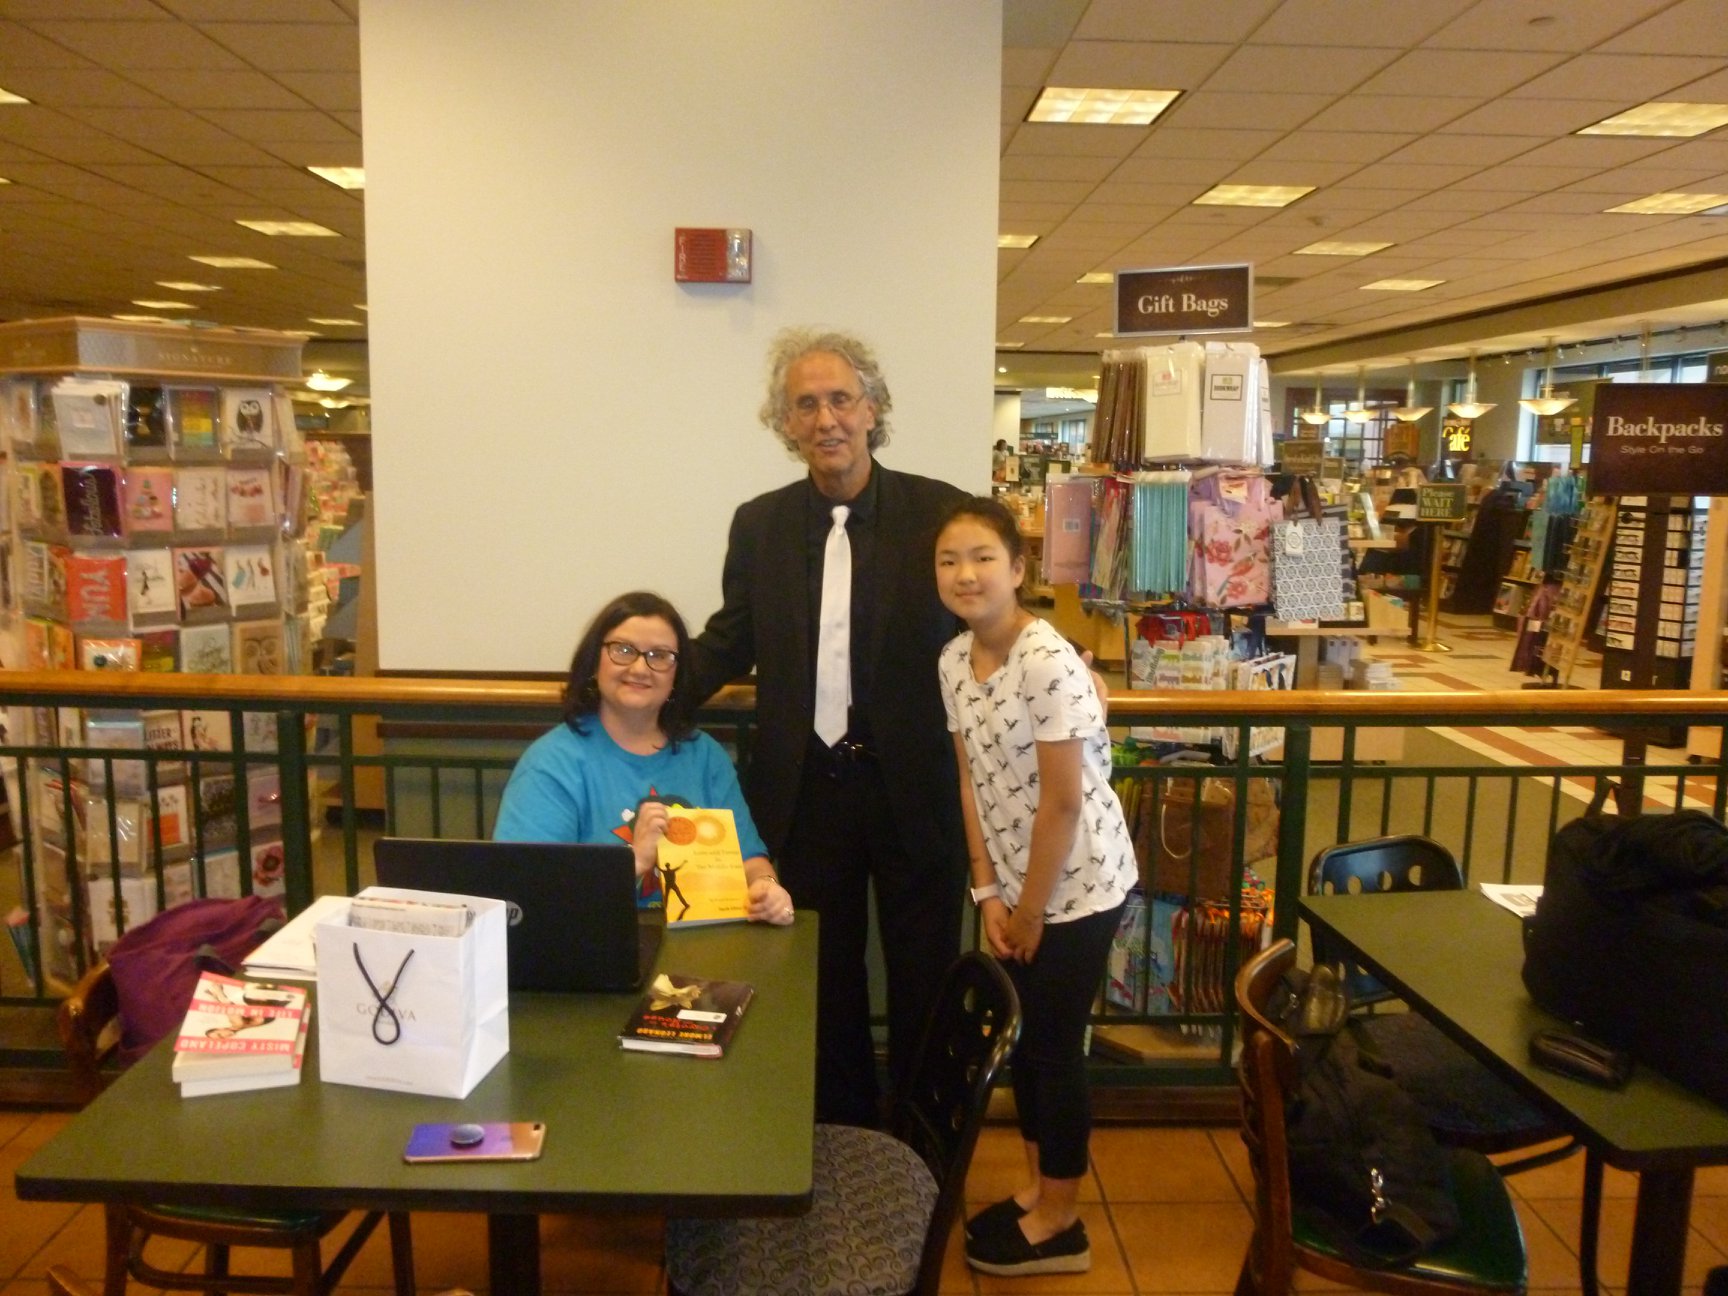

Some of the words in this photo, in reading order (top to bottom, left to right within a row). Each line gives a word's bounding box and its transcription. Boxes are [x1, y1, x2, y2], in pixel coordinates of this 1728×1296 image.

[1138, 294, 1175, 314] Gift
[1181, 293, 1229, 318] Bags
[1606, 416, 1723, 444] Backpacks
[1620, 445, 1647, 455] Style
[1648, 445, 1665, 454] On
[1687, 445, 1705, 454] Go
[1422, 487, 1455, 497] Please
[1422, 497, 1455, 507] WAIT
[198, 1003, 245, 1016] MOTION
[250, 1008, 264, 1017] IN
[269, 1009, 293, 1018] LIFE
[179, 1038, 247, 1051] COPELAND
[250, 1041, 291, 1053] MISTY
